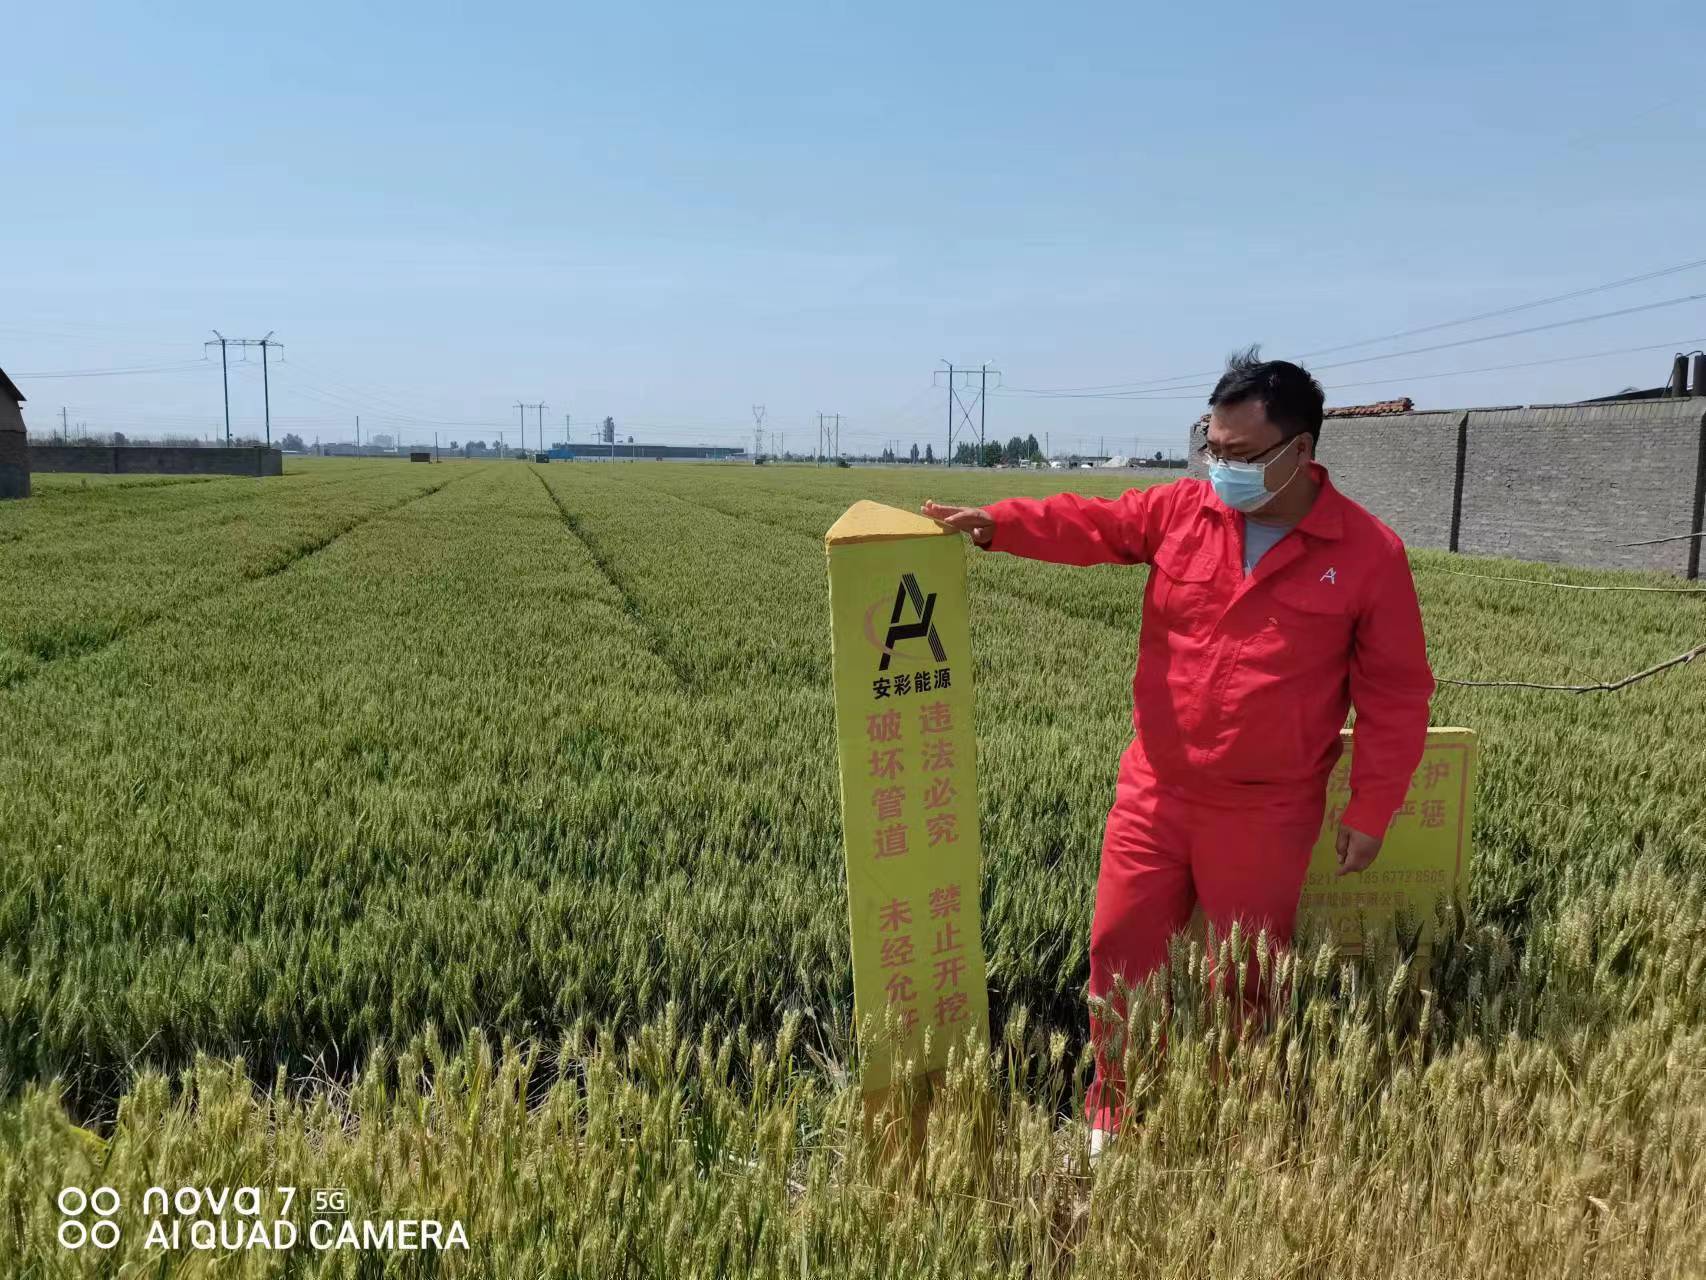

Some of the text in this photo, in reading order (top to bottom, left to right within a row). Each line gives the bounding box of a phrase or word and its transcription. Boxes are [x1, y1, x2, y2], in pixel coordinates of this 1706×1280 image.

[872, 669, 952, 699] 安彩能源
[865, 707, 910, 860] 破坏管道
[918, 701, 960, 847] 违法必究
[928, 883, 971, 1027] 禁止开挖
